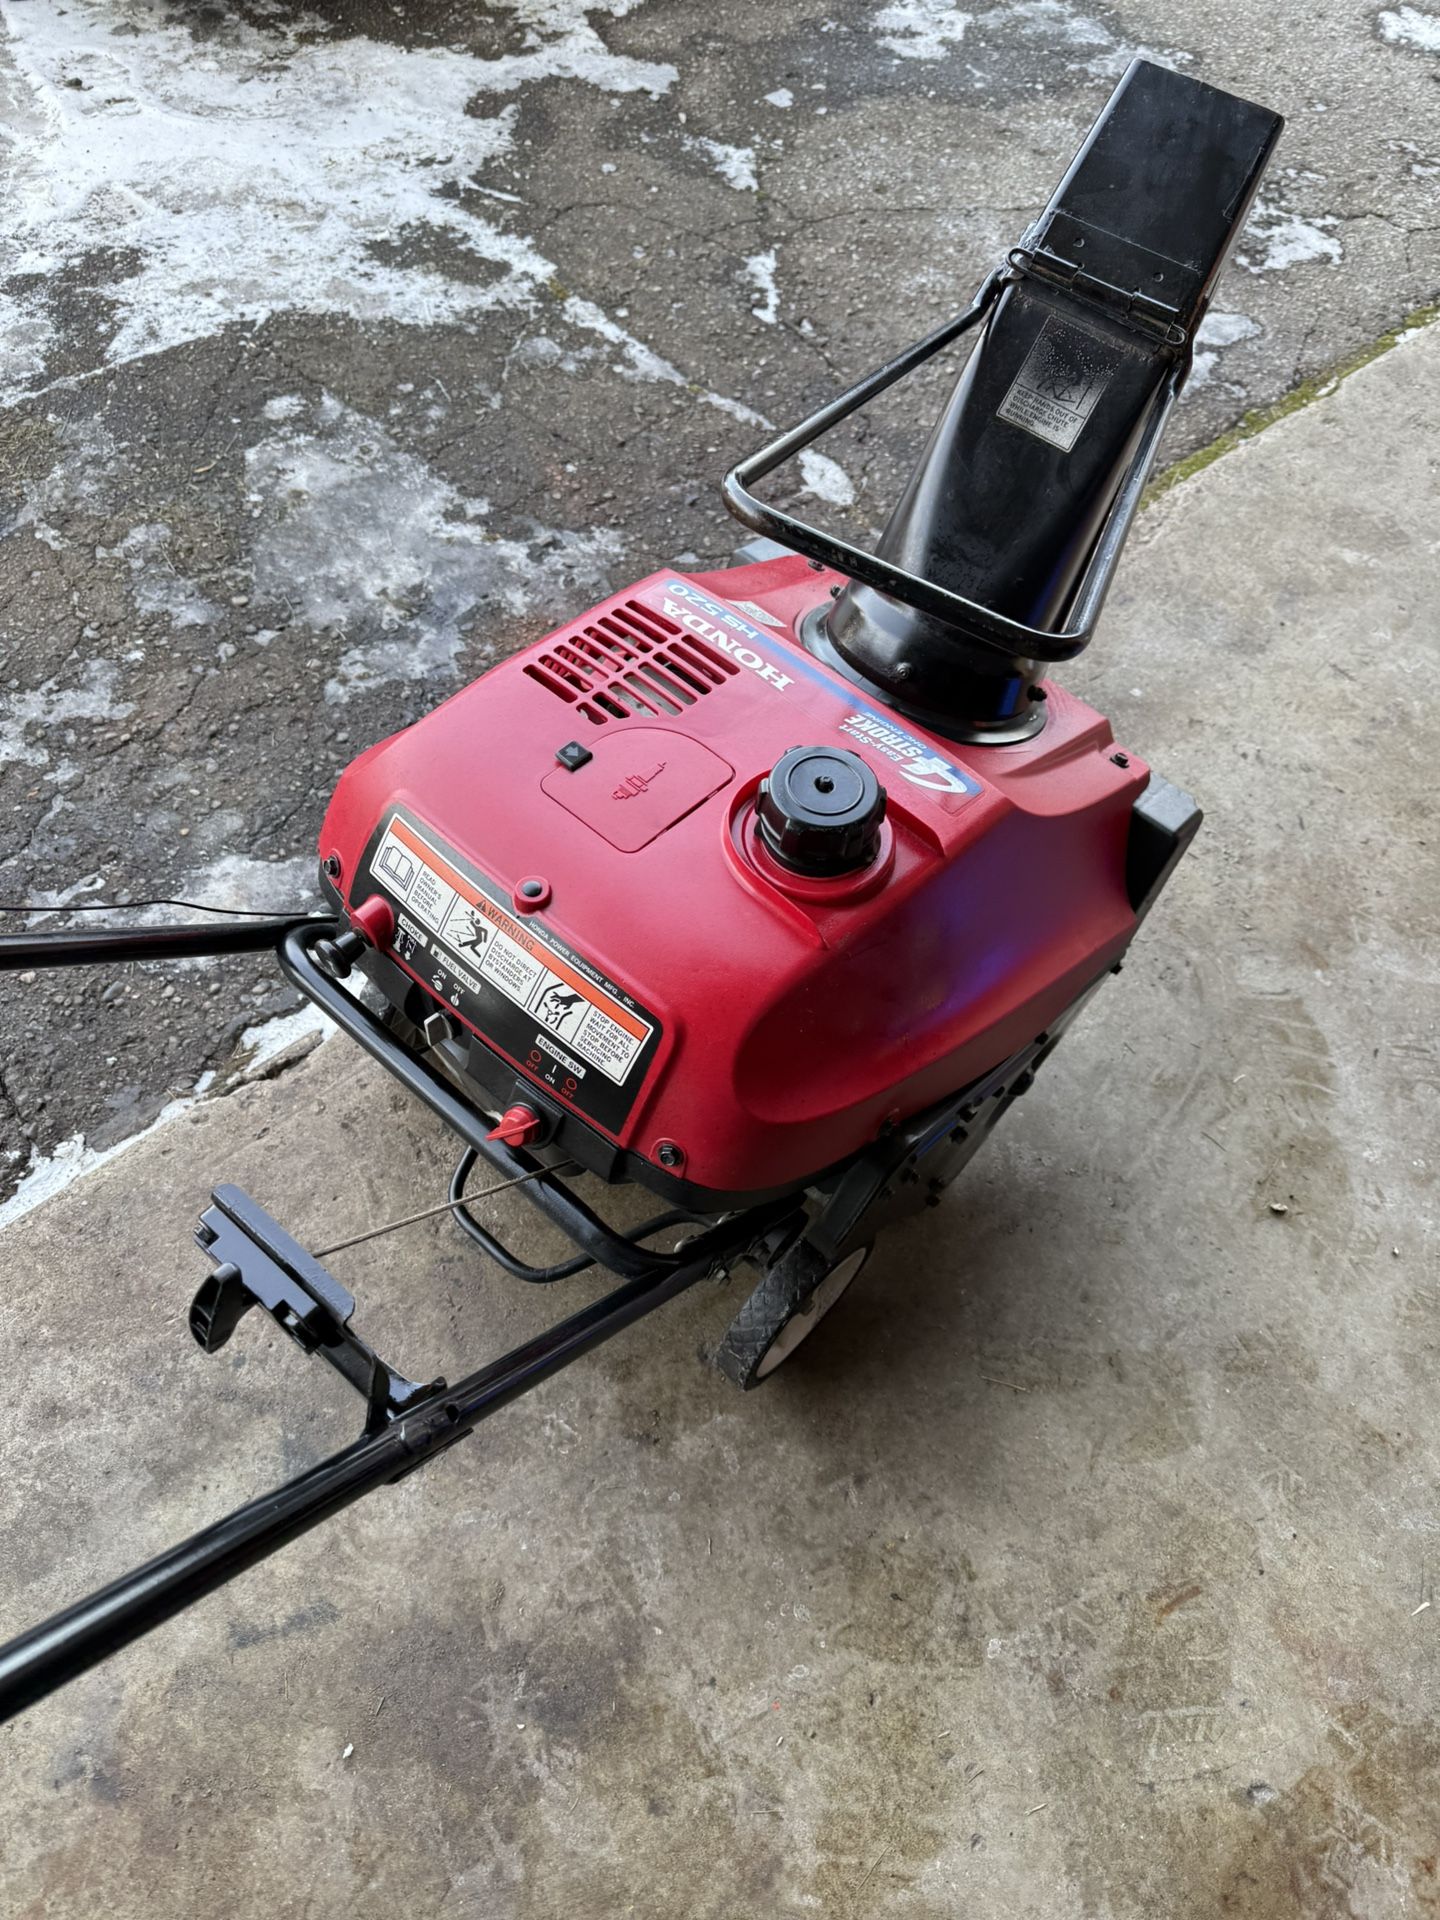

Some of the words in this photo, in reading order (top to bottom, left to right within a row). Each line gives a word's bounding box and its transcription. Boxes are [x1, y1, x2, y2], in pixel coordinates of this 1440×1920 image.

[1009, 402, 1029, 415] WHILE
[1030, 412, 1053, 428] ENGINE
[1047, 412, 1069, 428] CHUTE
[1055, 408, 1069, 419] OUT
[1069, 415, 1078, 424] OF
[668, 584, 723, 616] 520
[720, 614, 760, 640] HS
[663, 597, 795, 691] HONDA
[864, 711, 902, 734] ENGINE
[838, 724, 904, 762] Easy-Start
[844, 714, 923, 758] STROKE
[899, 756, 968, 793] 4
[422, 870, 437, 885] READ
[413, 889, 433, 910] BEFORE
[416, 883, 438, 906] MANUAL
[401, 918, 423, 942] CHOKE
[488, 909, 535, 951] WARNING
[485, 960, 495, 970] OR
[490, 947, 523, 976] DISCHARGE
[522, 973, 532, 983] AT
[494, 940, 504, 951] DO
[503, 947, 516, 960] NOT
[516, 958, 537, 978] DIRECT
[529, 921, 549, 940] HONDA
[549, 938, 570, 957] POWER
[570, 955, 603, 983] EQUIPMENT
[437, 969, 447, 980] ON
[442, 957, 457, 974] FUEL
[458, 969, 478, 991] VALVE
[488, 953, 525, 986] BYSTANDERS
[453, 983, 466, 994] OFF
[592, 1010, 610, 1025] STOP
[583, 1029, 600, 1043] STOP
[599, 1042, 624, 1063] BEFORE
[586, 1023, 620, 1051] MOVEMENT
[621, 1049, 630, 1059] TO
[589, 1016, 606, 1031] WAIT
[606, 1029, 619, 1041] FOR
[619, 1039, 630, 1051] ALL
[537, 1037, 567, 1064] ENGINE
[580, 1035, 613, 1063] SERVICING
[526, 1060, 539, 1071] OFF
[544, 1073, 556, 1085] ON
[561, 1087, 575, 1099] OFF
